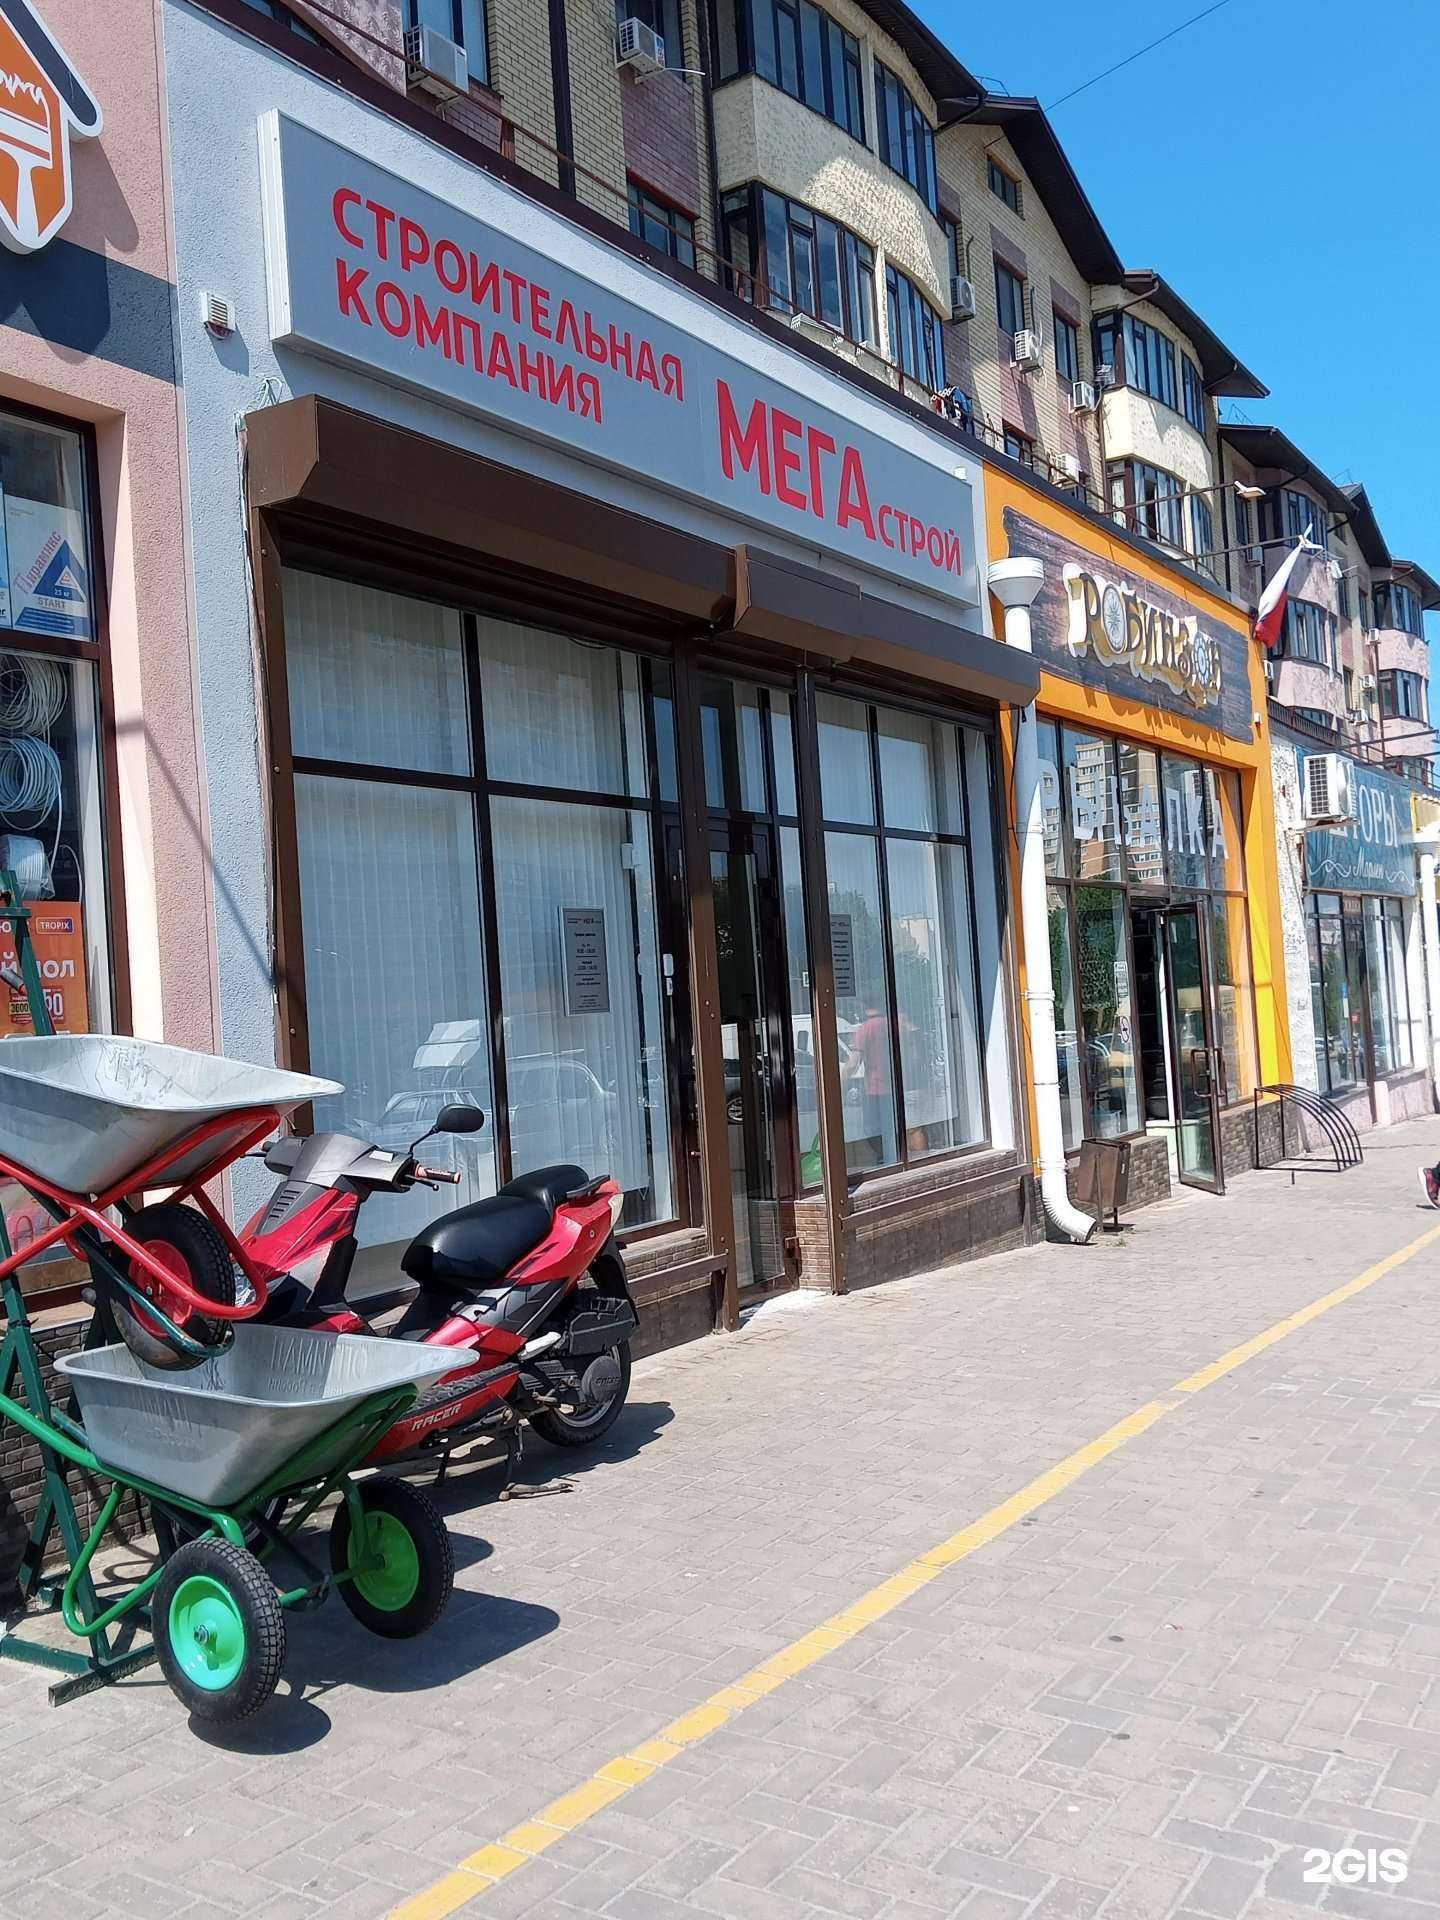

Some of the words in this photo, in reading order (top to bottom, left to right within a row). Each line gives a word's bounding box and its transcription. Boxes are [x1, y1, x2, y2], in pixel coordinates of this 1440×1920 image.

[332, 187, 685, 402] СТРОИТЕЛЬНАЯ
[335, 257, 603, 424] КОМПАНИЯ
[38, 597, 65, 609] START
[40, 920, 70, 930] TROPIX
[411, 1403, 462, 1431] RACER
